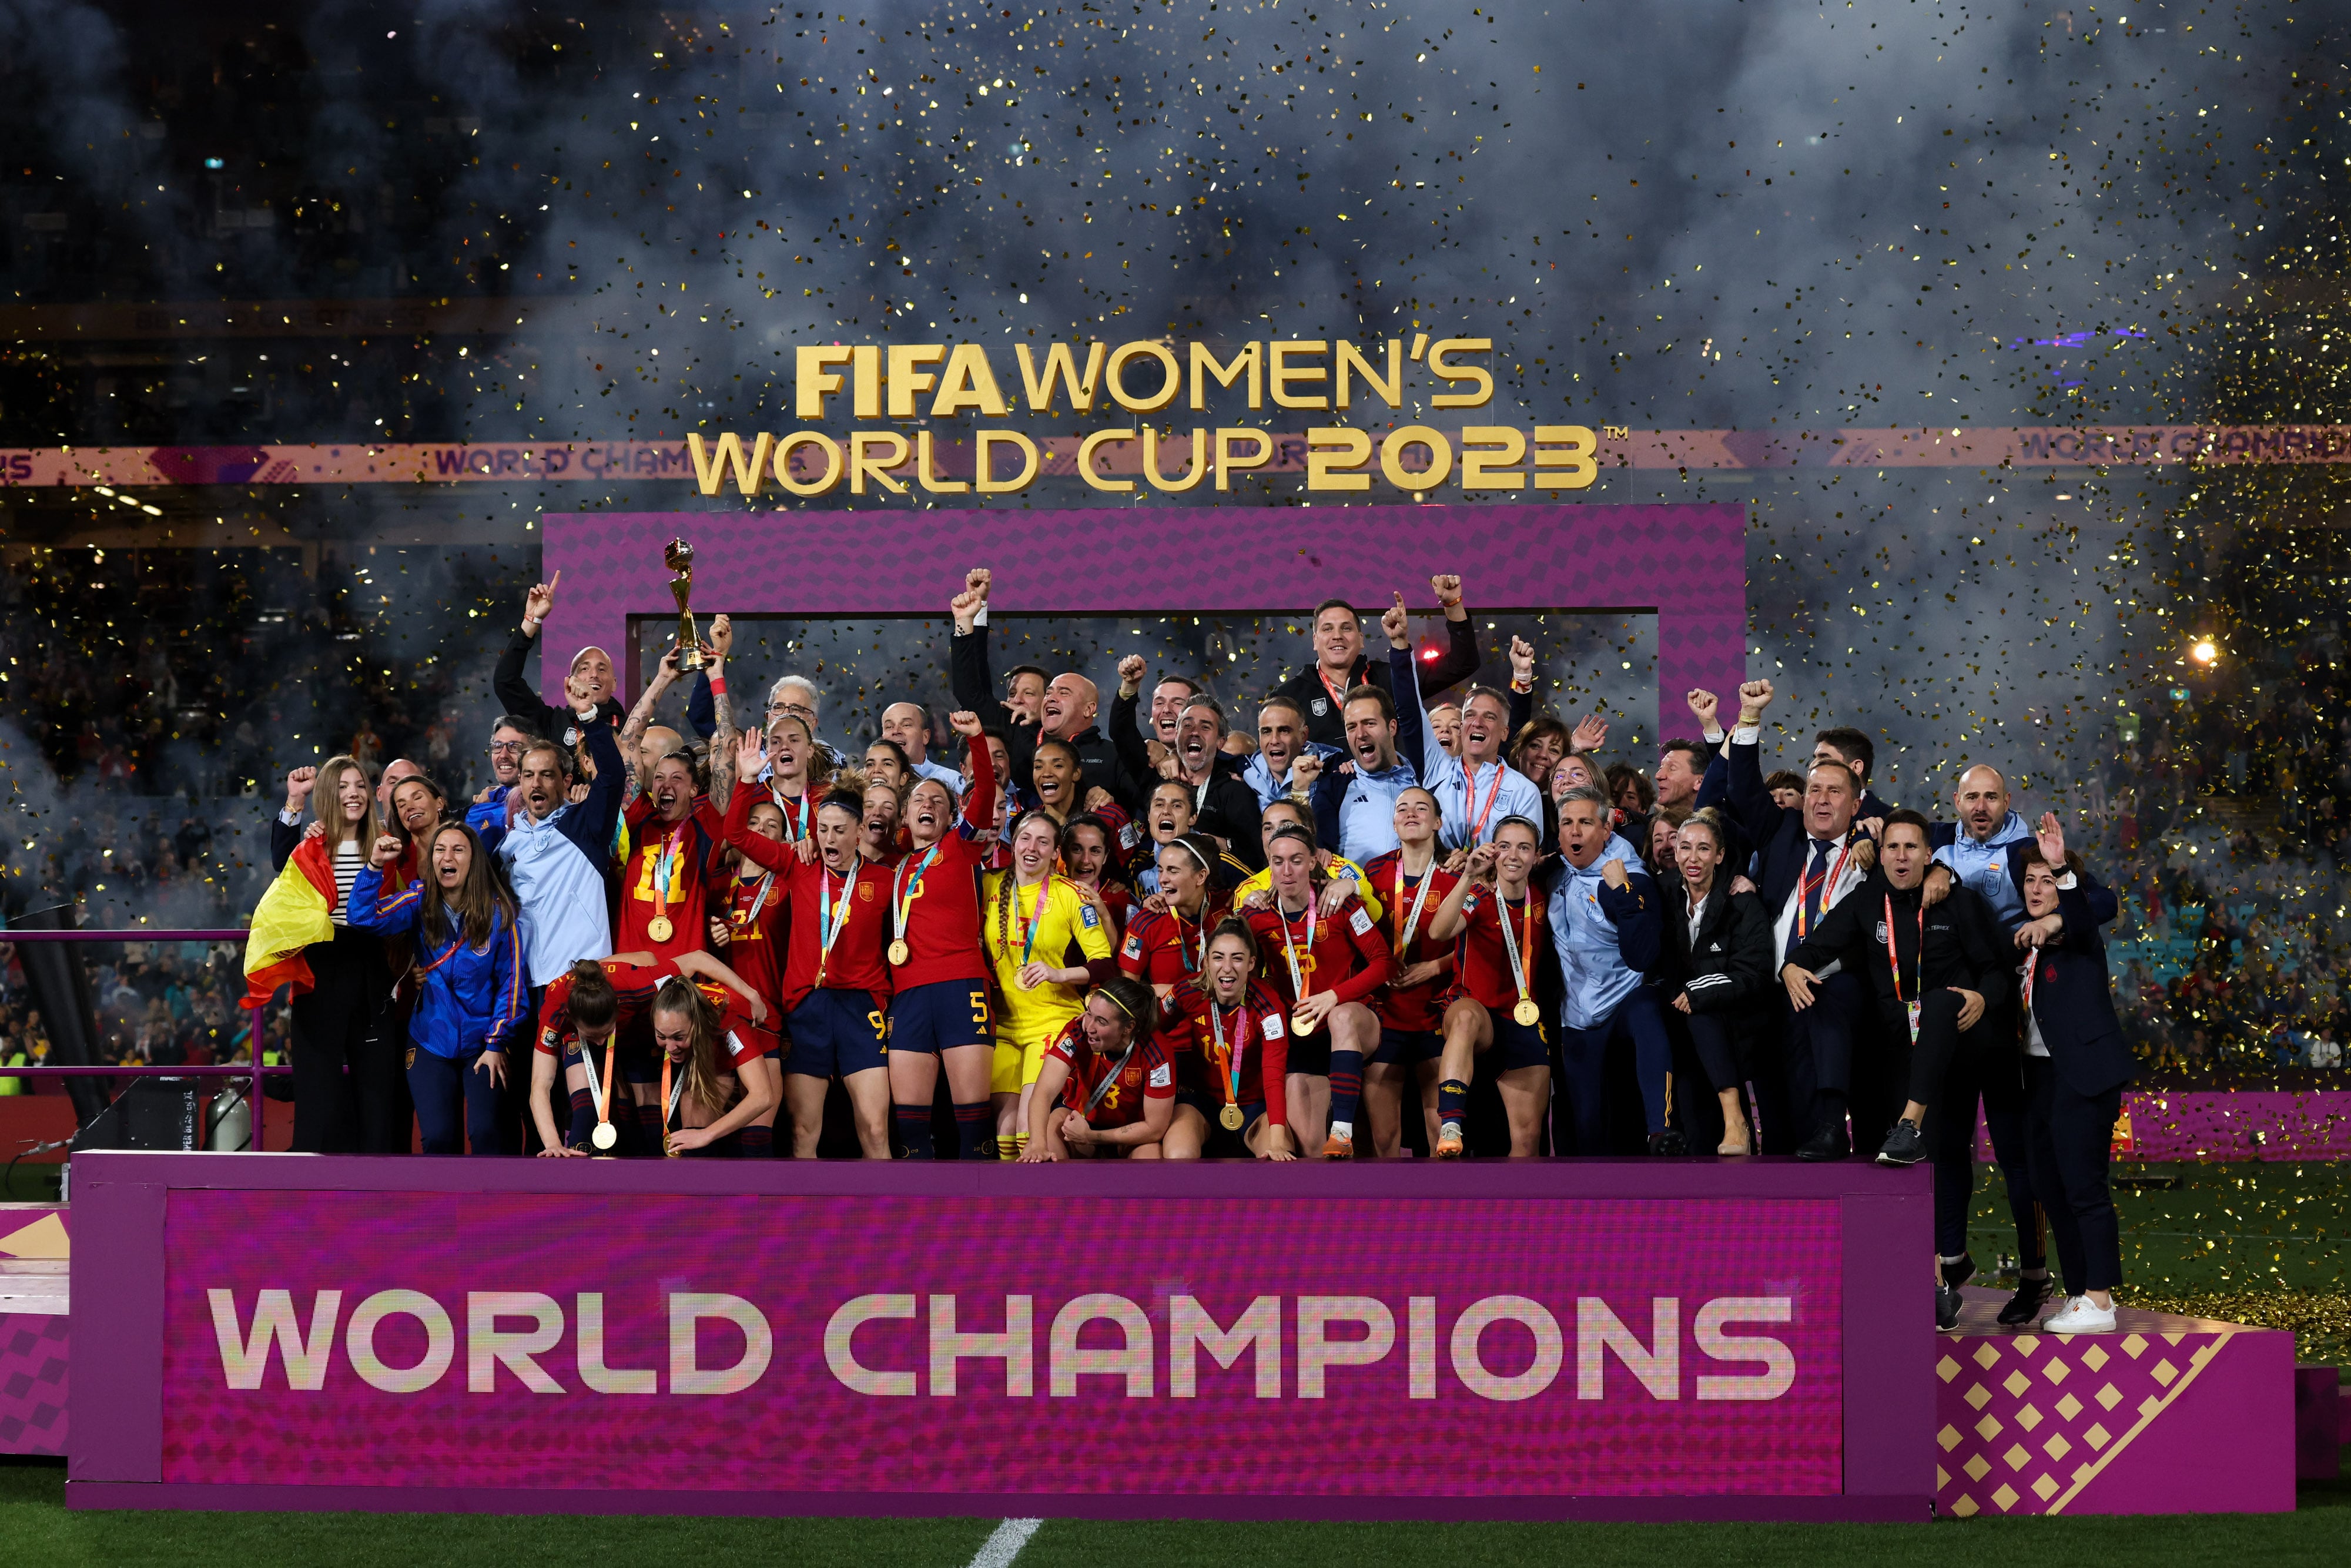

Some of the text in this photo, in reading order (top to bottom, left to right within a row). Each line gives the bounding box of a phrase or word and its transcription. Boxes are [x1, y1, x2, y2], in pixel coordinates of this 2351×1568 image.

[796, 333, 1494, 419] FIFA WOMEN'S
[2019, 432, 2163, 460] WORLD
[435, 449, 570, 475] WORLD
[686, 430, 1040, 497] WORLD
[1077, 427, 1274, 494] CUP
[731, 909, 762, 941] 21
[1281, 945, 1317, 974] 15
[970, 992, 988, 1023] 5
[867, 1011, 886, 1040] 9
[1201, 1035, 1231, 1065] 19
[1106, 1071, 1116, 1083] WORLD
[208, 1288, 1796, 1401] WORLD CHAMPIONS
